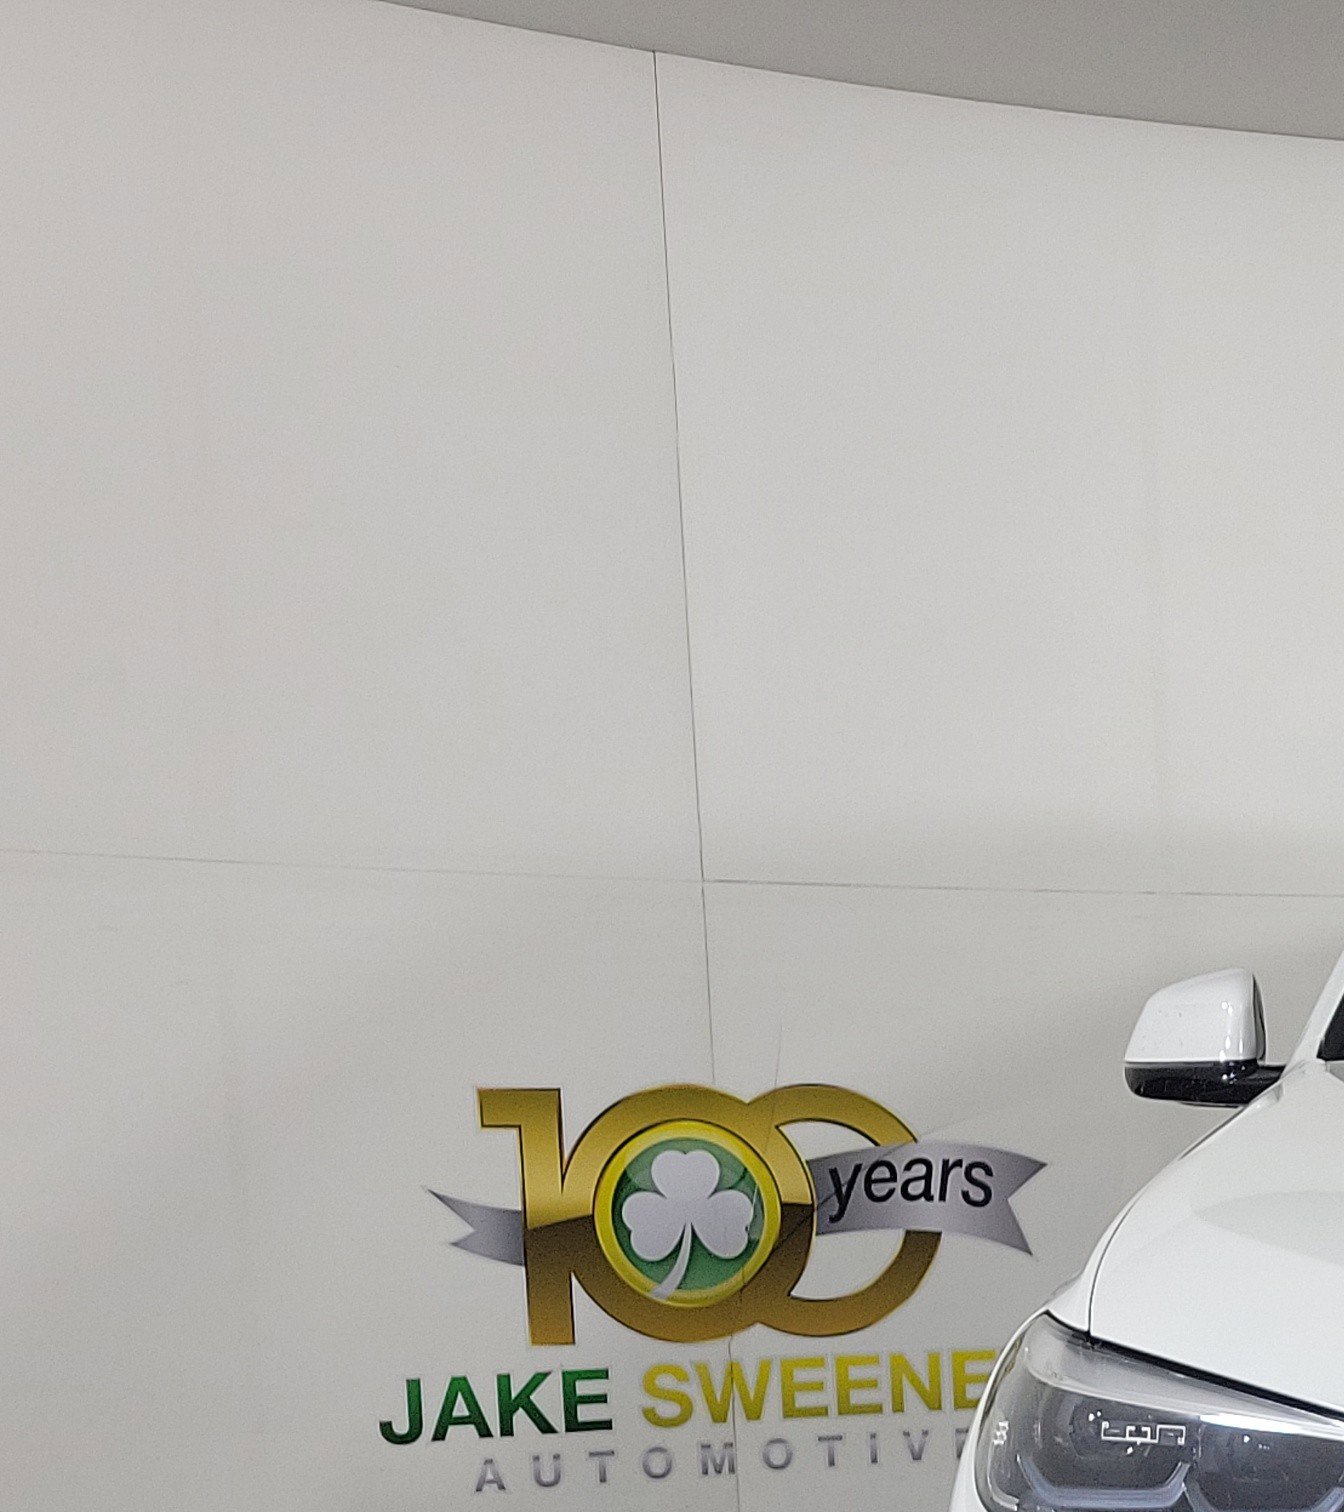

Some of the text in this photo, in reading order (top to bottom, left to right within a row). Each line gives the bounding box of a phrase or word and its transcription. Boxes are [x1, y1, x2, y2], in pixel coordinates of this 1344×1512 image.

[477, 1083, 941, 1346] 100
[828, 1157, 994, 1222] years
[379, 1350, 996, 1445] JAKE SWEENE
